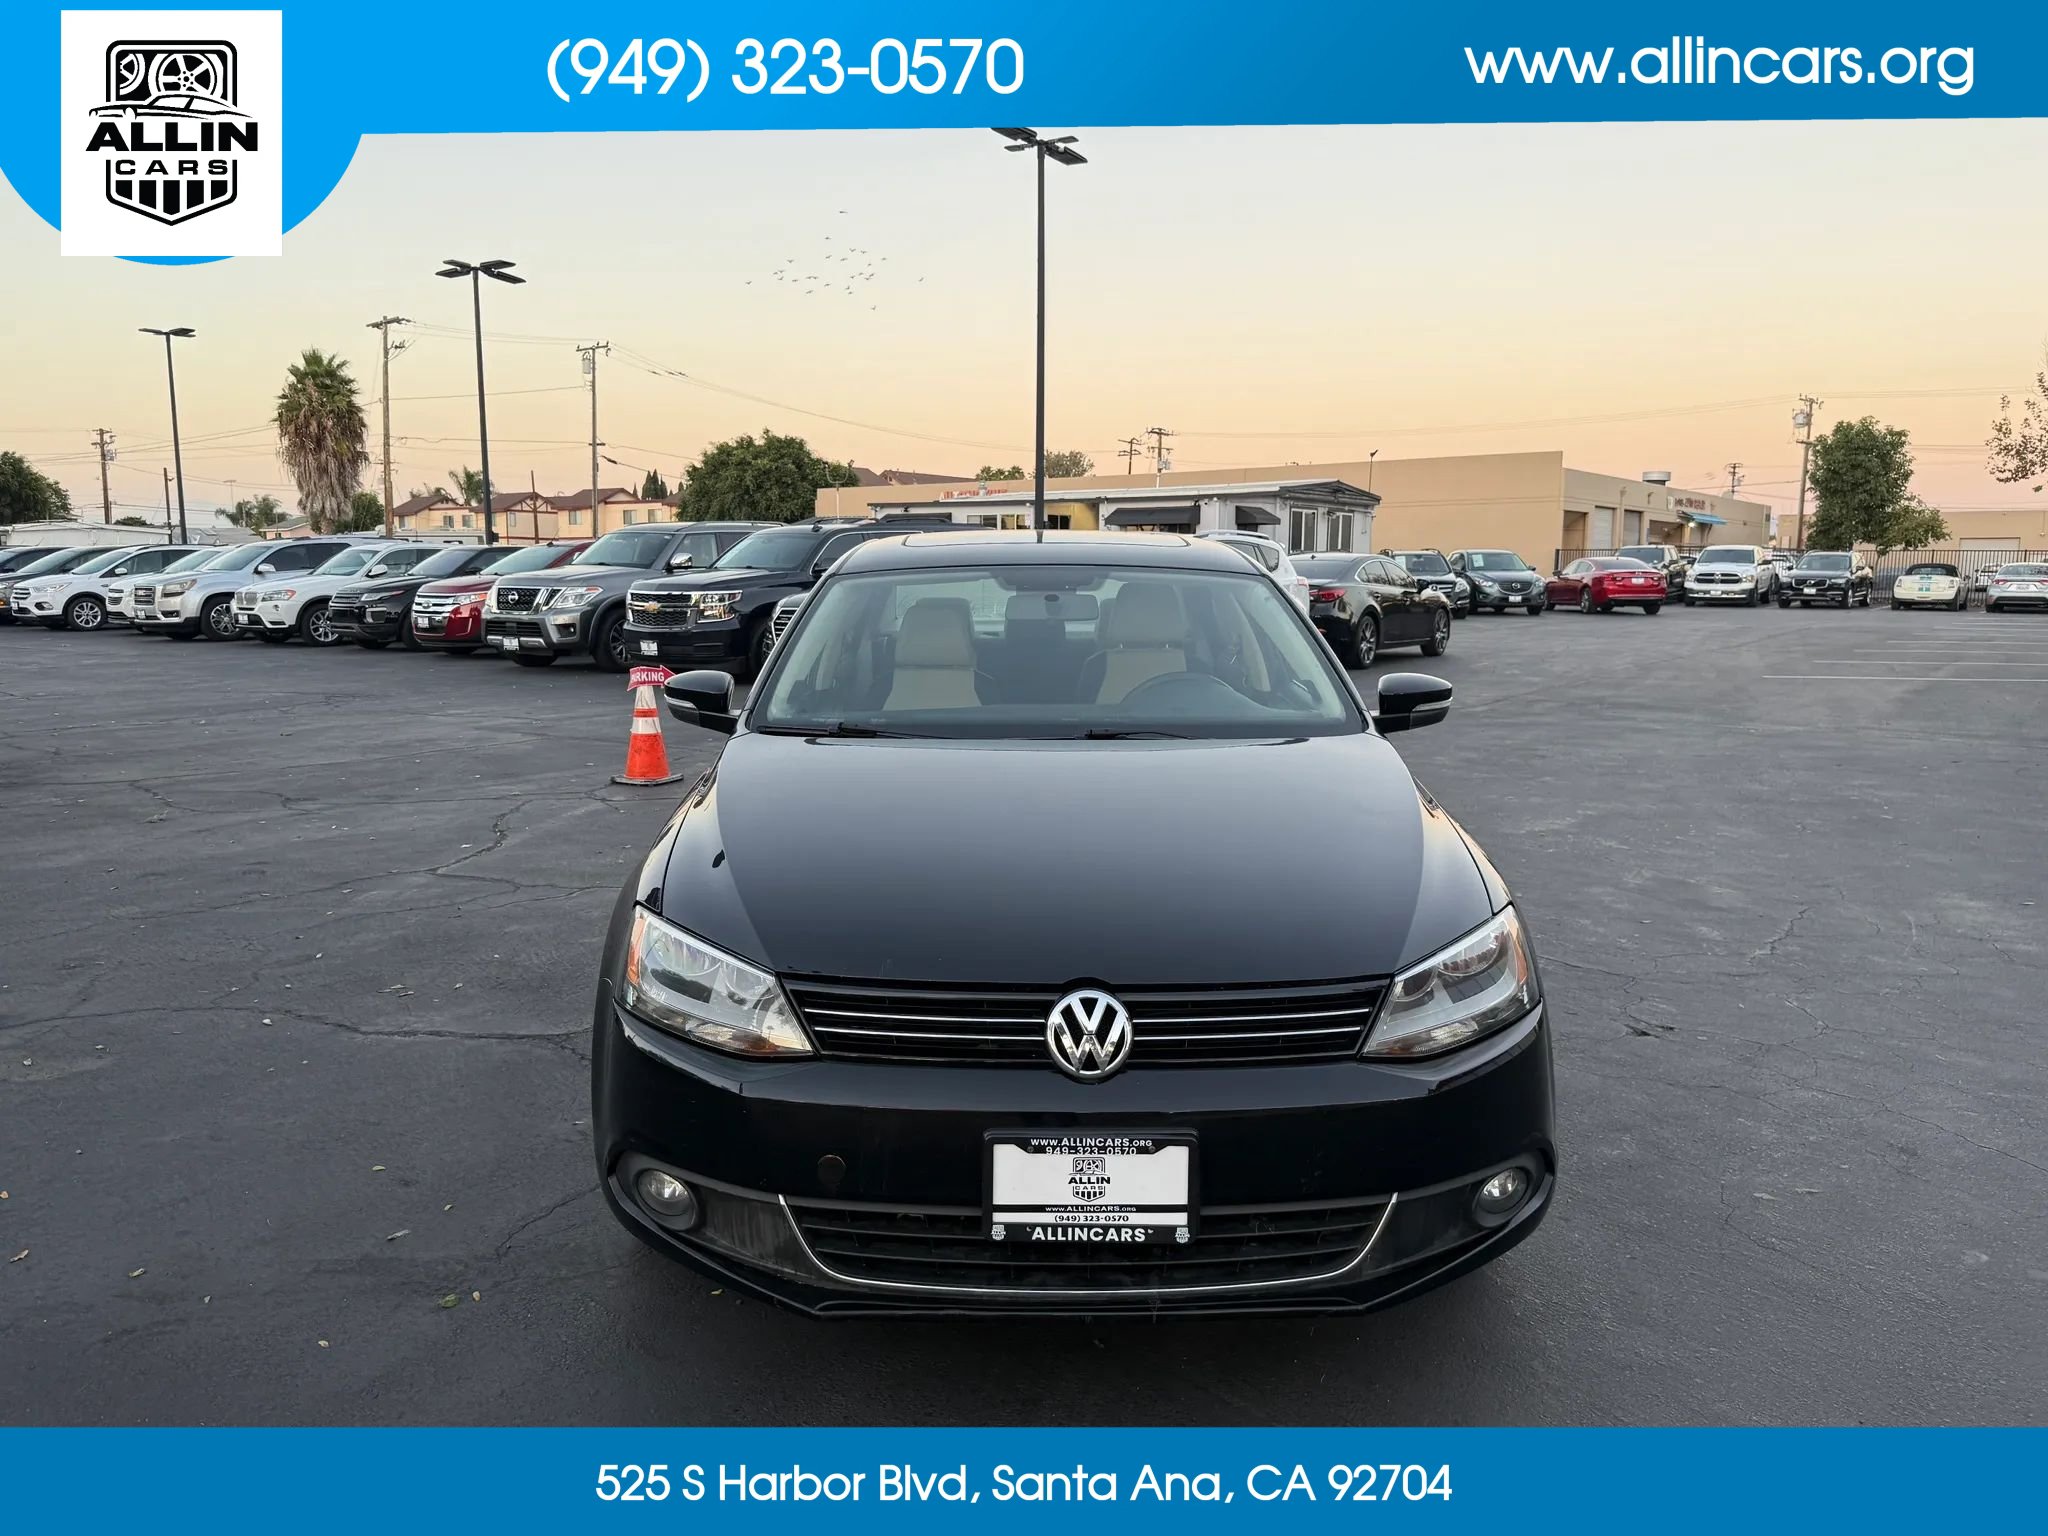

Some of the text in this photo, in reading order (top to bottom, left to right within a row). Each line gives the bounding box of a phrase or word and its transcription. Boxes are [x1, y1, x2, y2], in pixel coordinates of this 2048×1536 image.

[1045, 1146, 1137, 1156] 949-323-0570
[1068, 1176, 1111, 1185] ALLIN
[1054, 1214, 1129, 1223] (949) 323-0570
[1031, 1226, 1146, 1242] ALLINCARS
